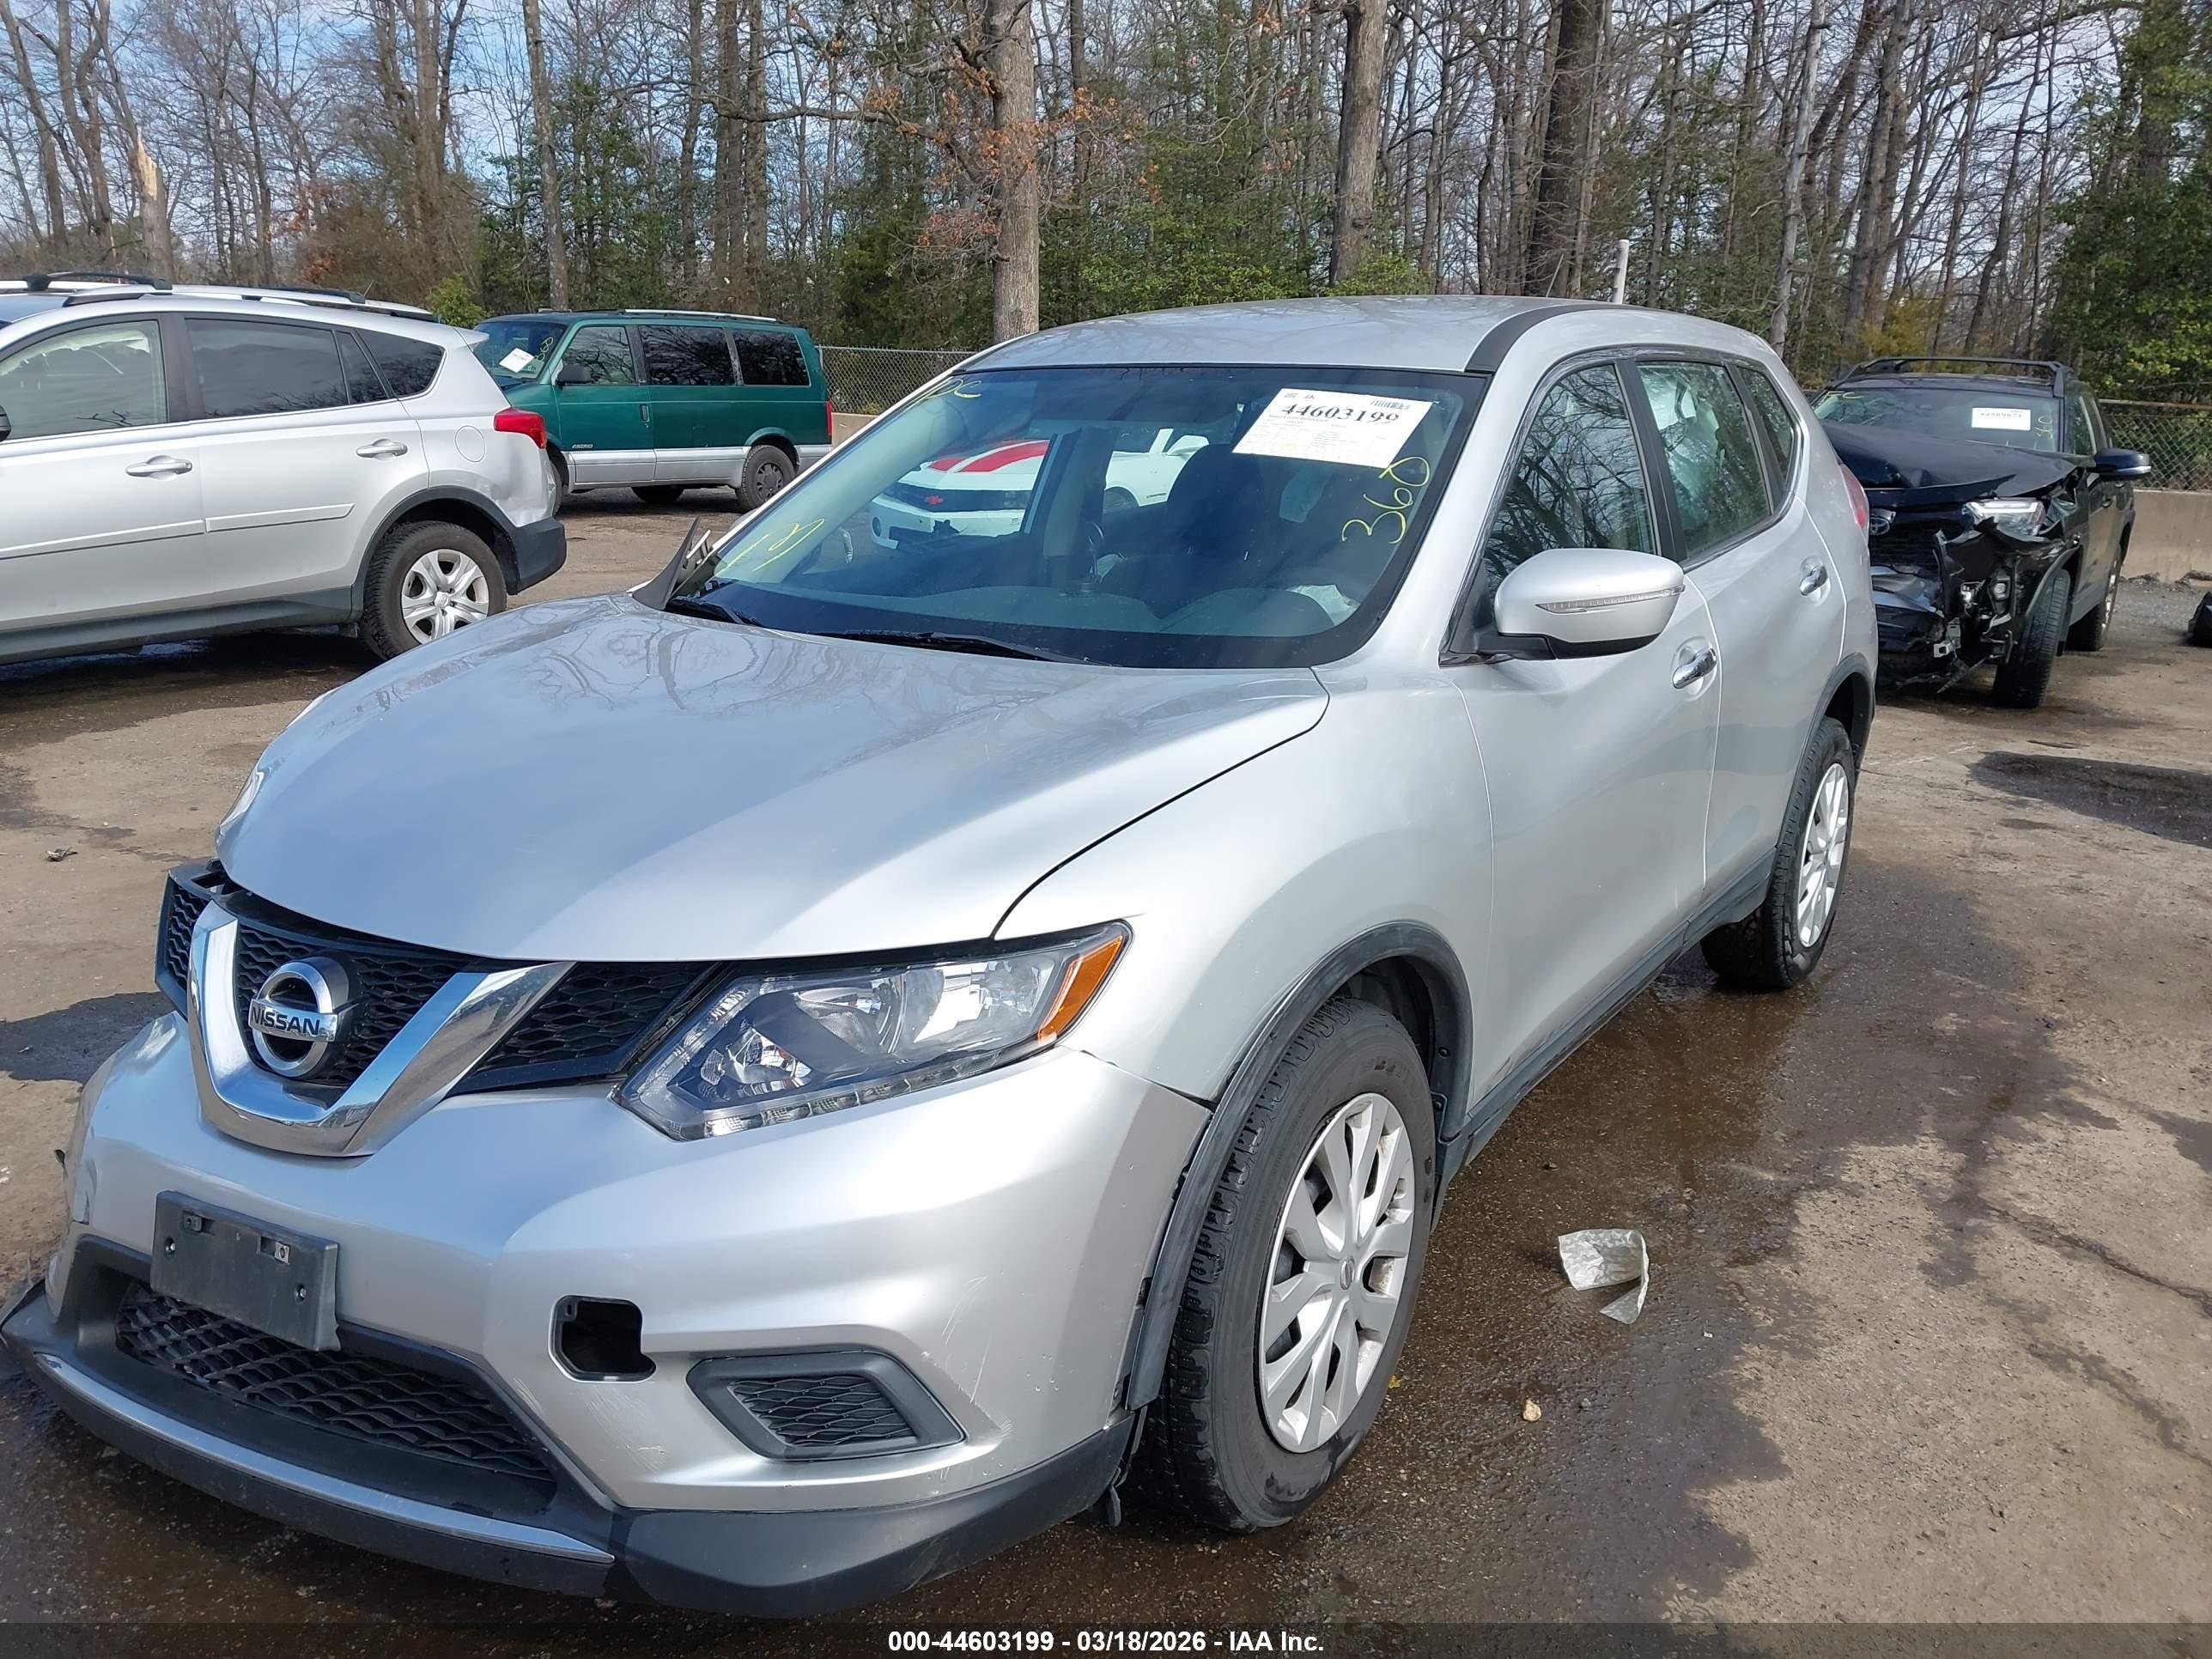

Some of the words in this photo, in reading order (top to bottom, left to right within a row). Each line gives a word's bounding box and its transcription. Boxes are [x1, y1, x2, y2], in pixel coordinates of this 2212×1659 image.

[1282, 404, 1400, 424] 44603199
[1340, 457, 1431, 544] 360
[251, 1006, 320, 1036] NISSAN
